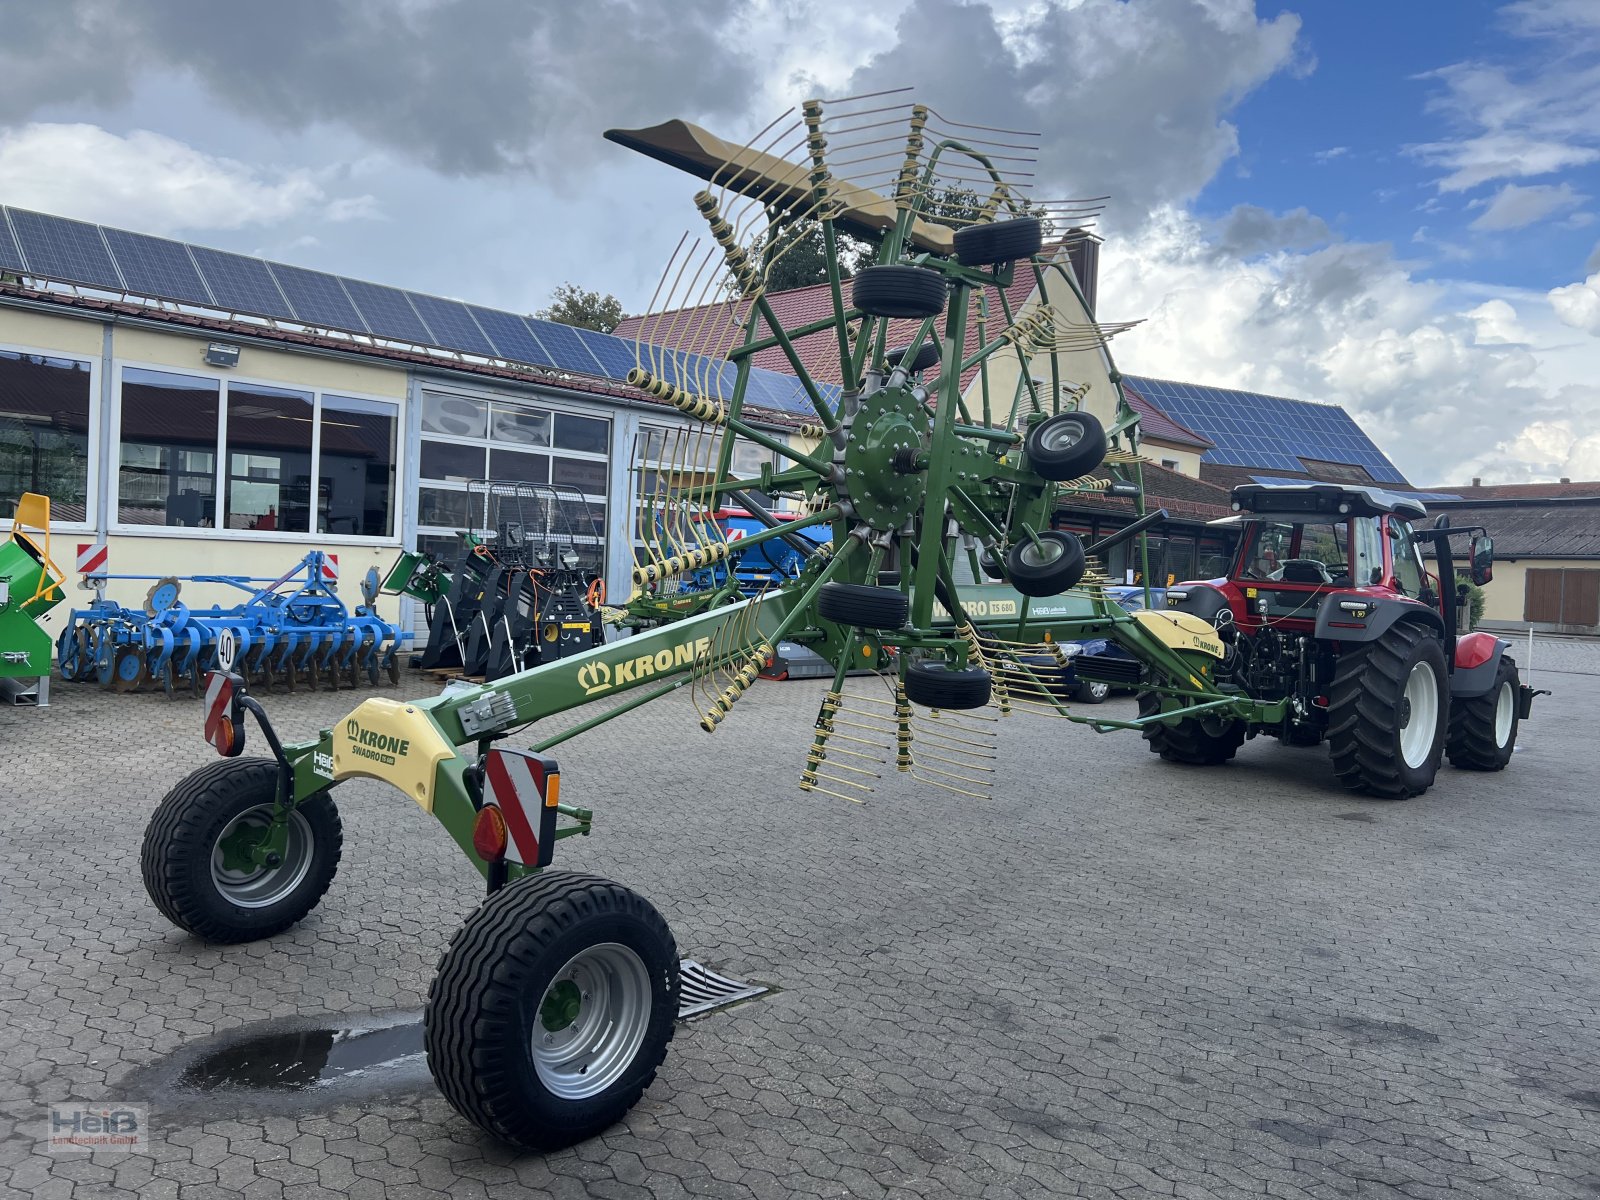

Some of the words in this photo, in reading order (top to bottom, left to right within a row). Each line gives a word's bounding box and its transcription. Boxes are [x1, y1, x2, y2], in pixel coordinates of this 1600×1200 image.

[992, 604, 1000, 612] TS
[1001, 604, 1014, 612] 680
[220, 634, 232, 664] 40
[1200, 640, 1219, 654] KRONE
[614, 637, 711, 686] KRONE
[359, 728, 410, 756] KRONE
[352, 745, 380, 762] SWADRO
